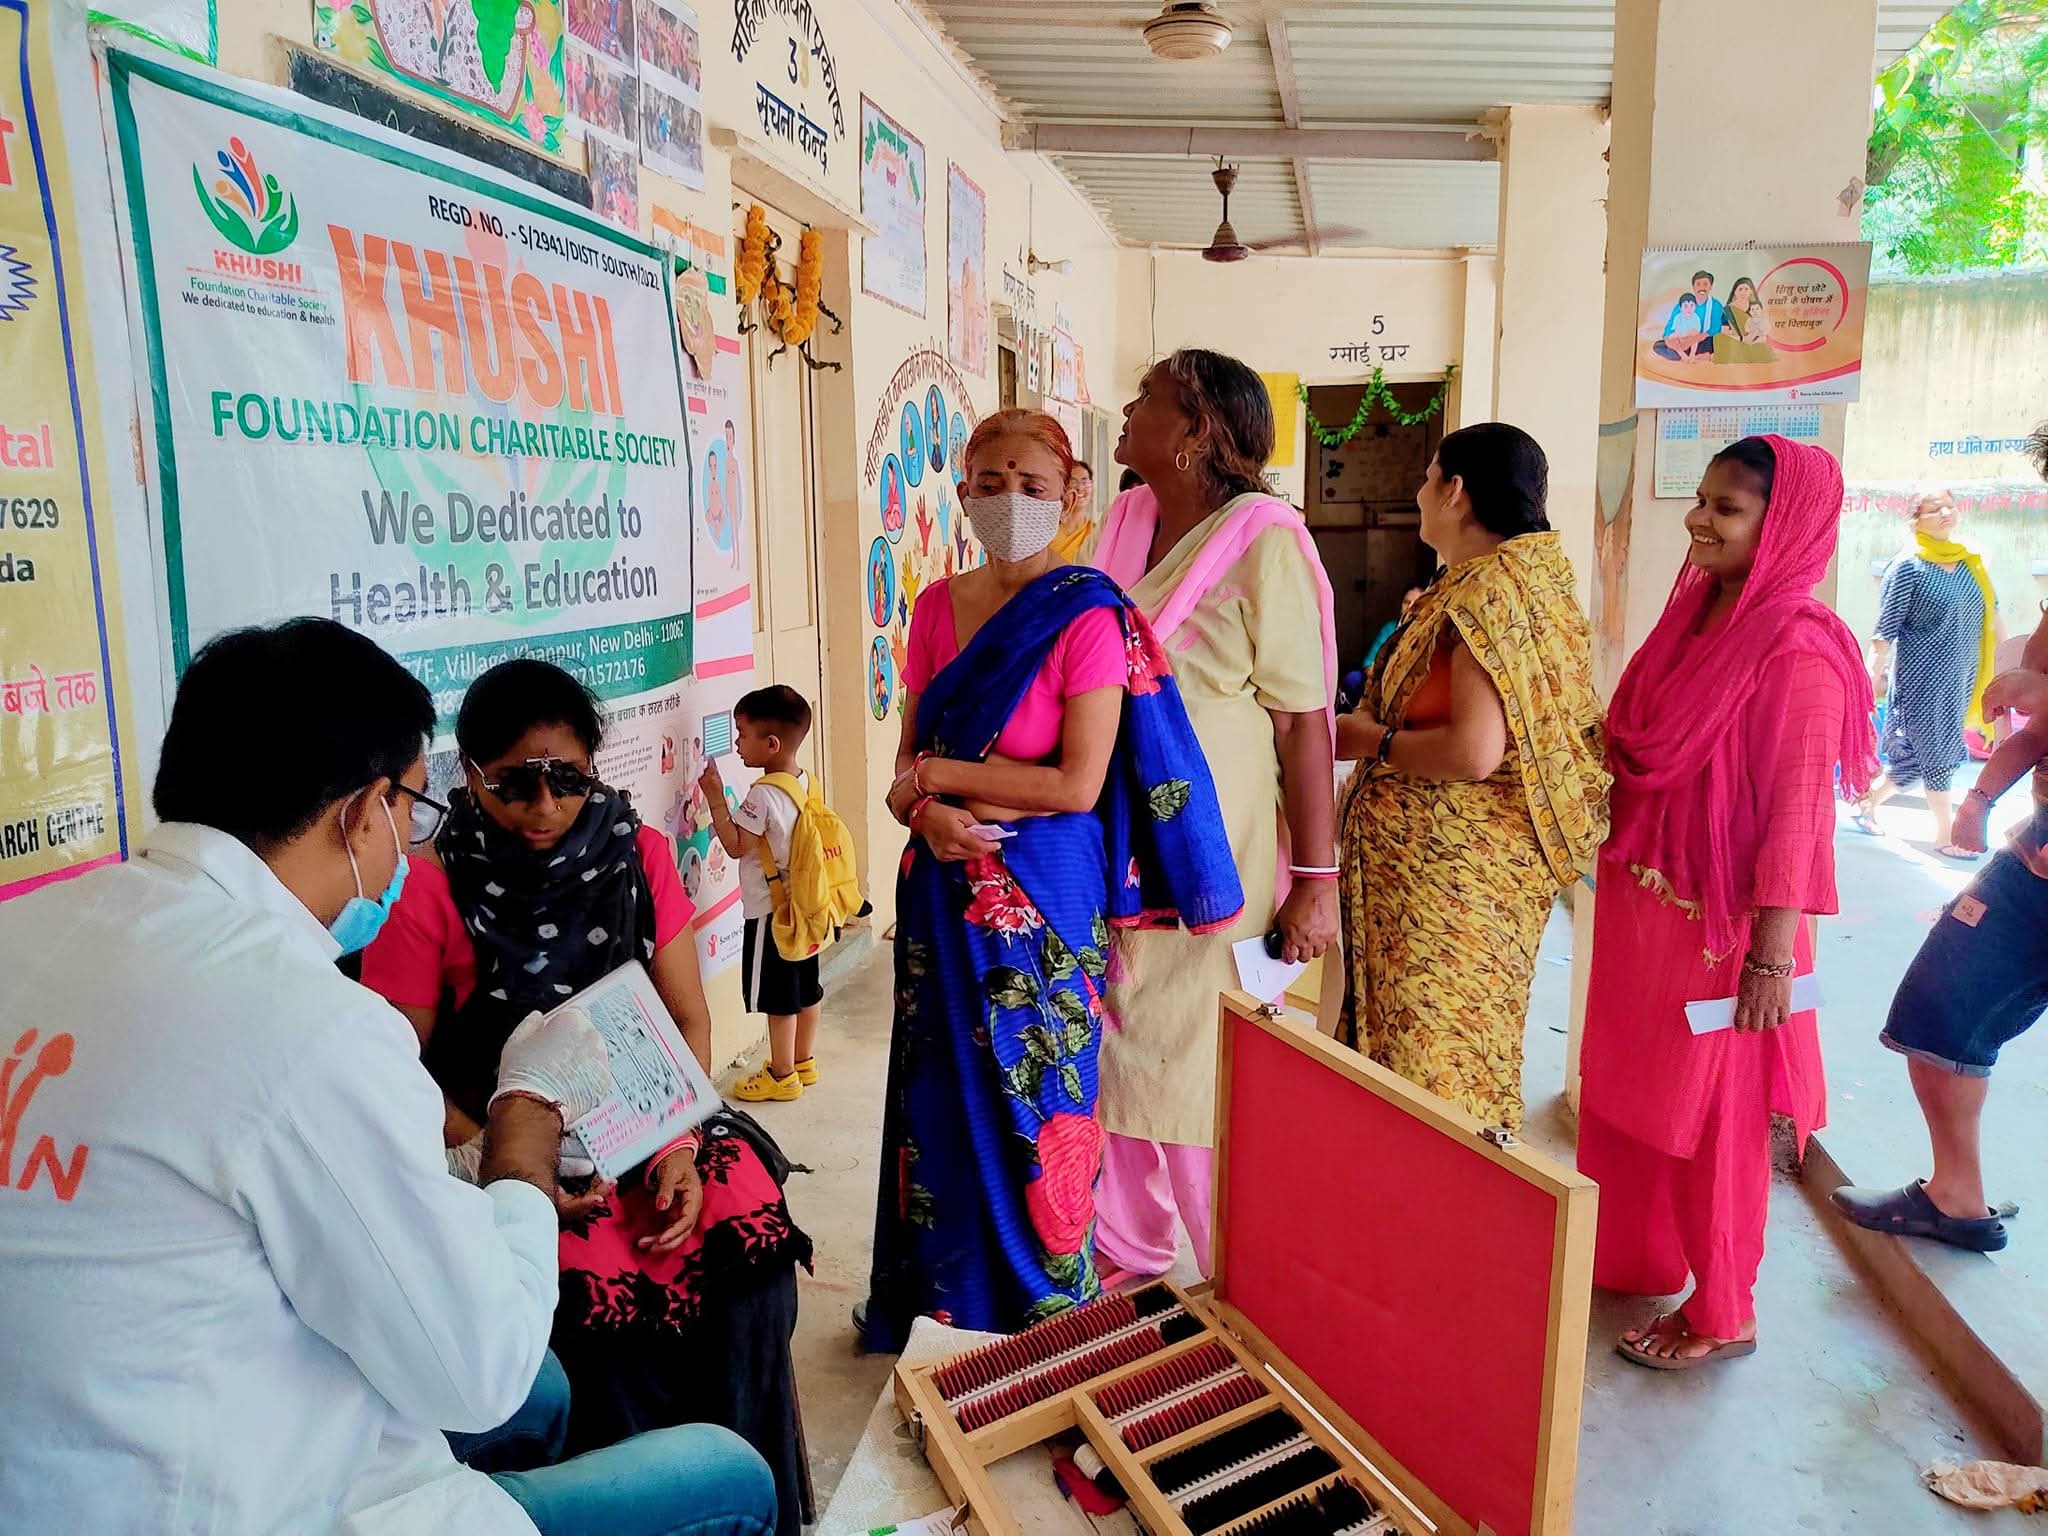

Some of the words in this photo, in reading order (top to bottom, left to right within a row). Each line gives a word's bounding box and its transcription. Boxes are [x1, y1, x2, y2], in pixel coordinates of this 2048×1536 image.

[428, 194, 478, 230] REGD.
[479, 214, 509, 239] NO.
[213, 249, 302, 283] KHUSHI
[182, 291, 199, 304] We
[202, 294, 245, 312] dedicated
[246, 303, 256, 314] to
[257, 304, 298, 321] education
[299, 310, 307, 322] &
[309, 311, 336, 325] health
[190, 276, 245, 297] Foundation
[247, 288, 296, 306] Charitable
[298, 297, 328, 312] Society
[327, 223, 625, 416] KHUSHI
[1371, 315, 1385, 335] 5
[1378, 344, 1410, 361] घर
[211, 390, 462, 452] FOUNDATION
[470, 416, 612, 463] CHARITABLE
[615, 432, 676, 468] SOCIETY
[361, 490, 434, 546] We
[447, 490, 610, 543] Dedicated
[617, 498, 642, 539] to
[330, 563, 472, 627] Health
[484, 562, 513, 614] &
[525, 557, 658, 610] Education
[589, 633, 620, 656] New
[623, 624, 654, 650] Delhi
[661, 619, 684, 643] 110062
[1, 663, 49, 716] बजे
[54, 671, 97, 709] तक
